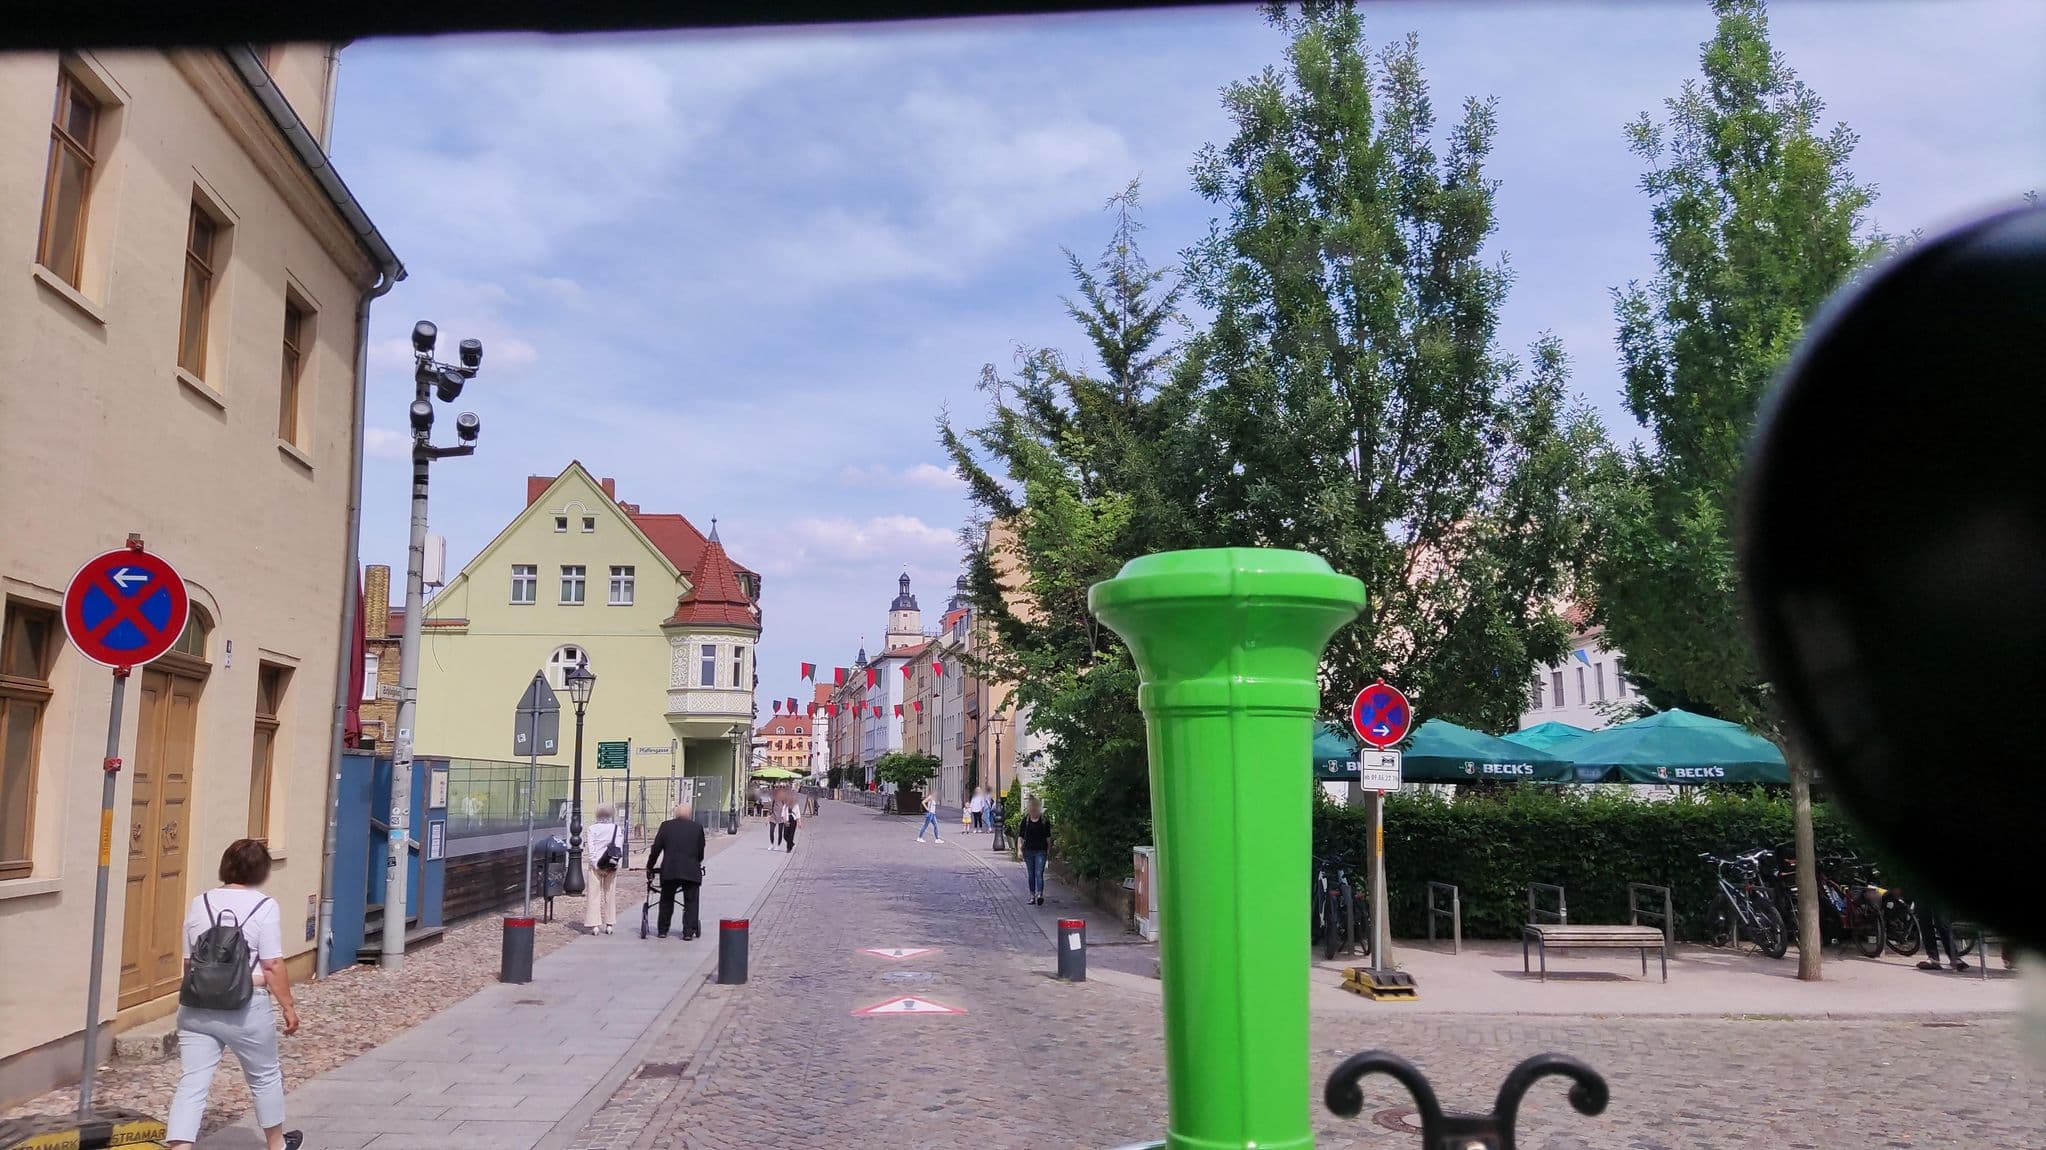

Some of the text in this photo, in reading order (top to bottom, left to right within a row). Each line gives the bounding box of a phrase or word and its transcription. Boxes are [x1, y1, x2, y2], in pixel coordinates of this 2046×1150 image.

[1483, 763, 1534, 774] BECK'S
[1675, 766, 1725, 778] BECK'S
[112, 1129, 166, 1144] STRAMAR
